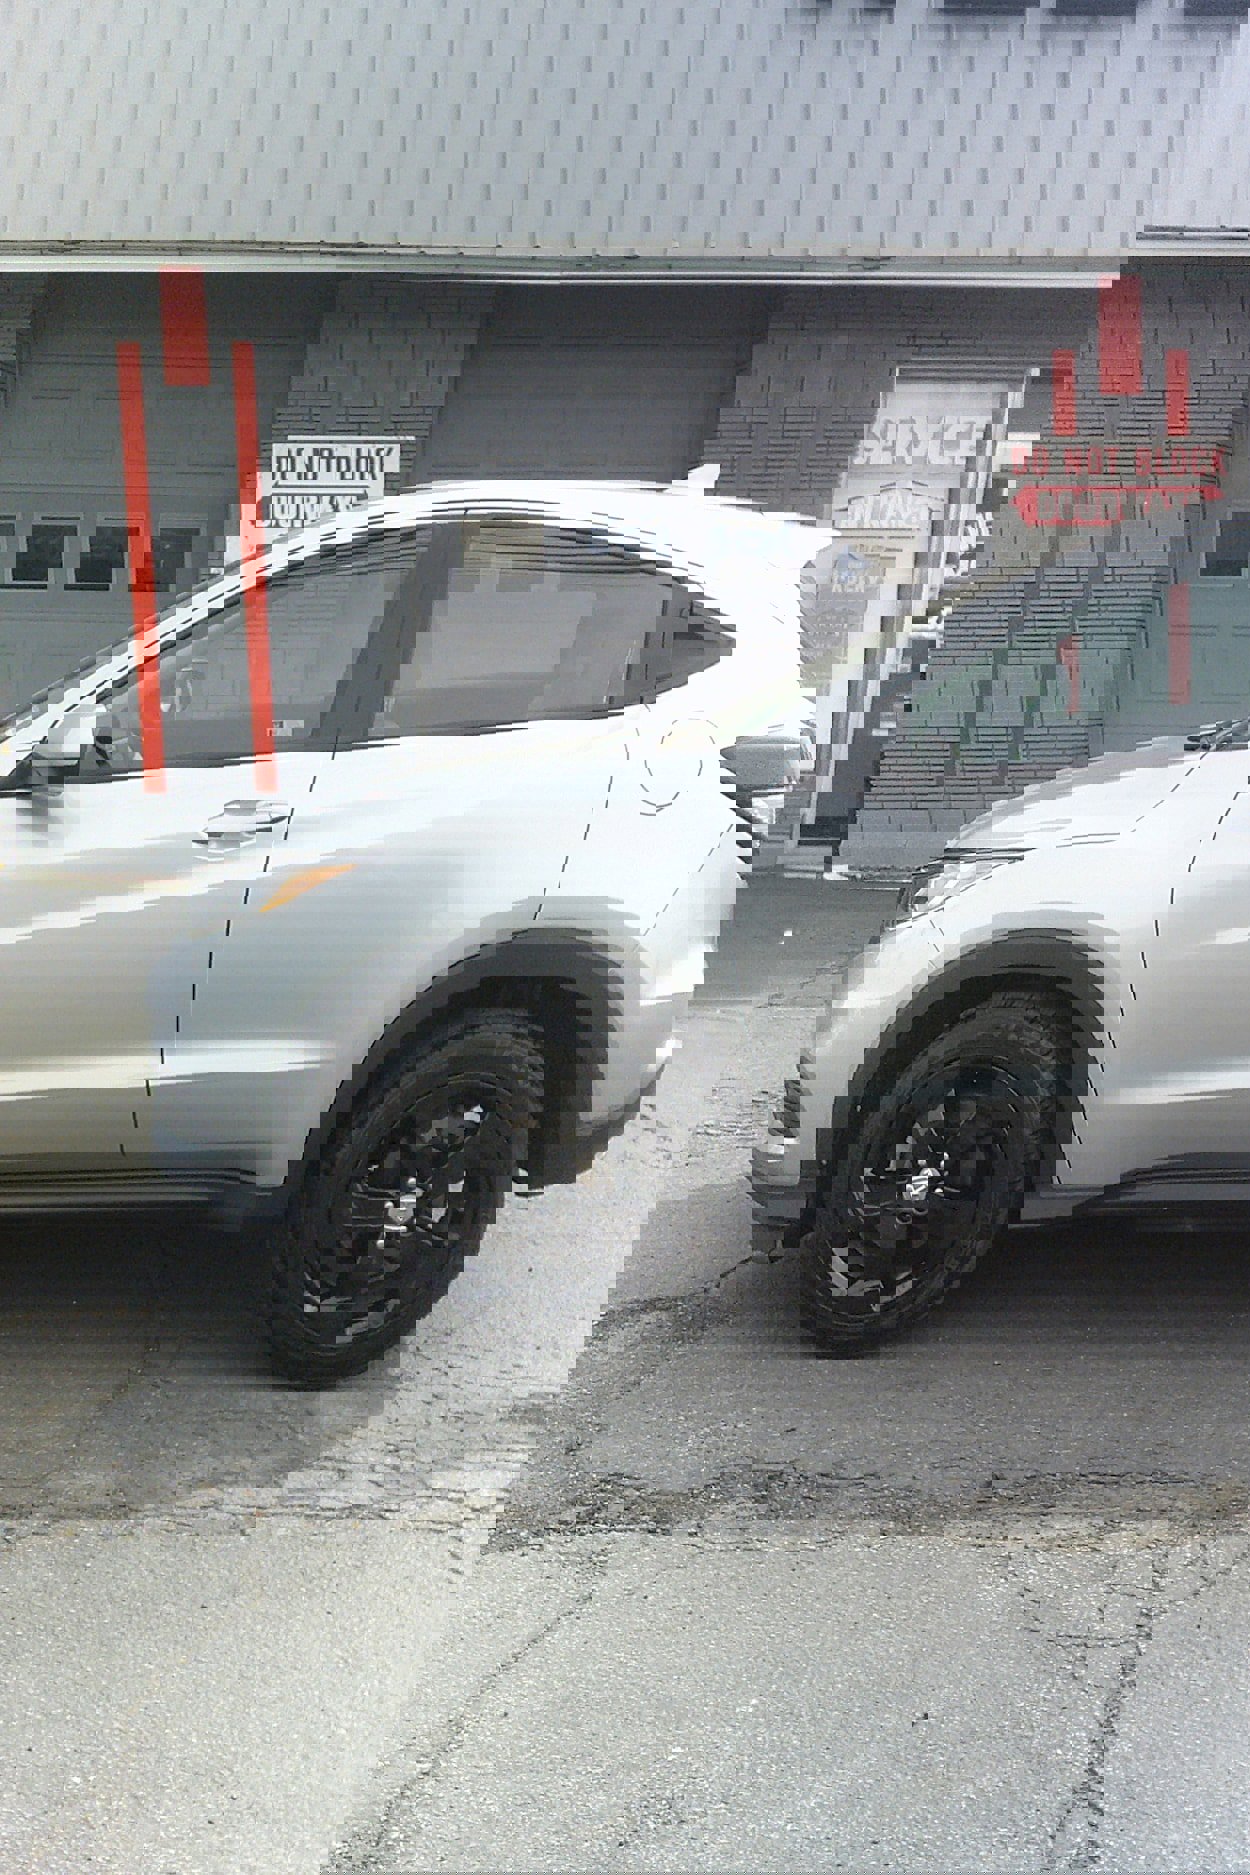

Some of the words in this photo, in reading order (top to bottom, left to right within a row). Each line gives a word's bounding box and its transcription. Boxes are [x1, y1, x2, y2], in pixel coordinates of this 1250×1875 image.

[1011, 446, 1048, 476] DO
[1064, 446, 1120, 476] NOT
[1135, 446, 1228, 477] BLOCK
